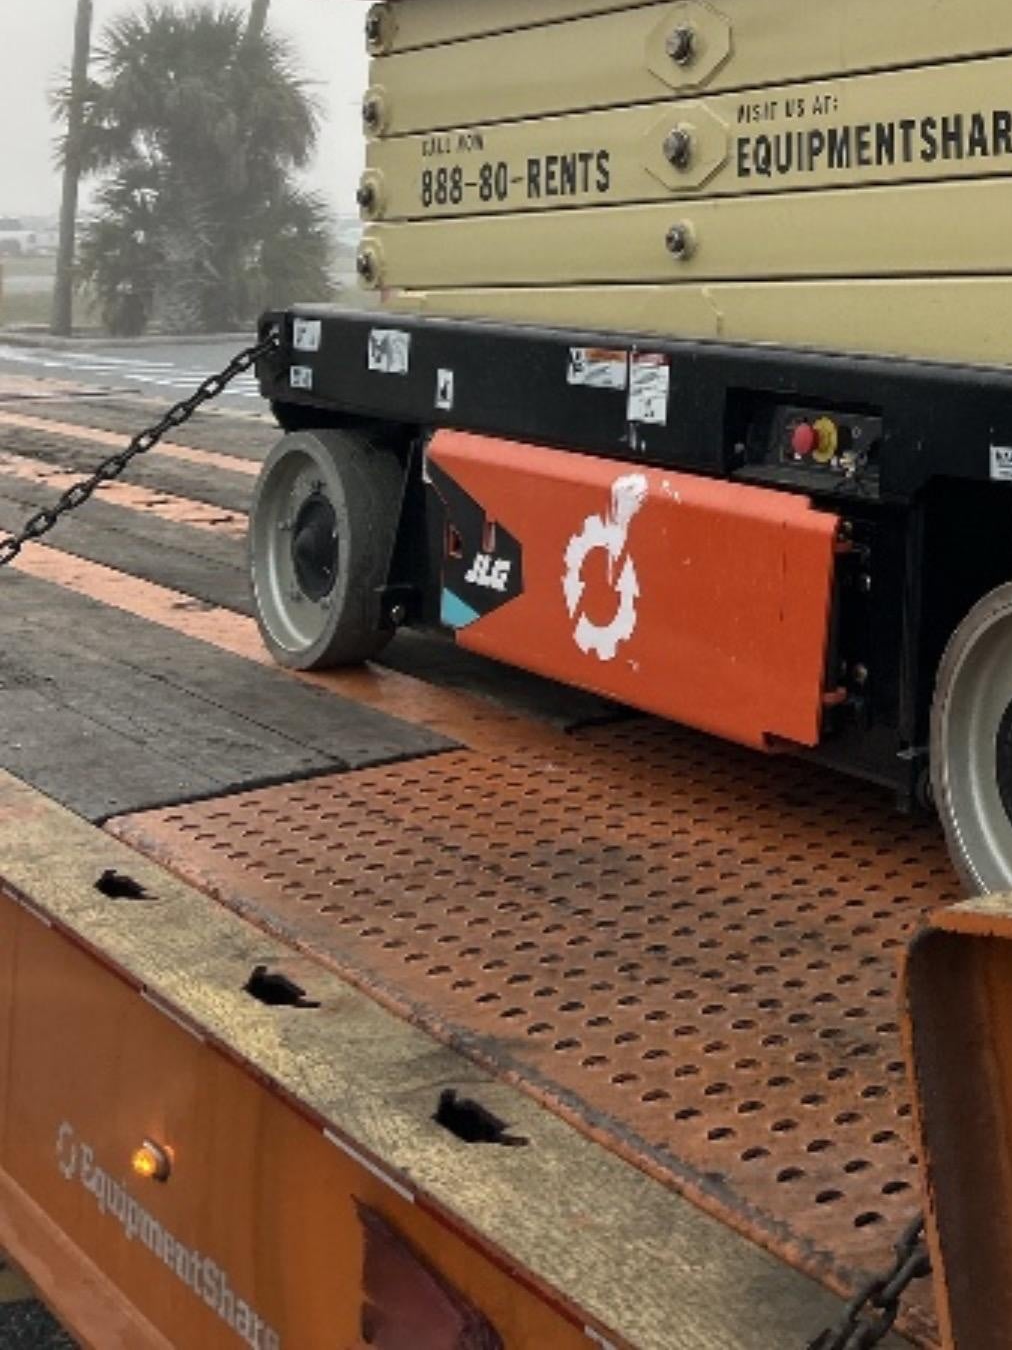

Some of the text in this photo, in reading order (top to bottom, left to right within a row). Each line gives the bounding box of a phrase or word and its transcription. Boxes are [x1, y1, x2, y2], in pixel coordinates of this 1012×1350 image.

[737, 95, 839, 123] VISIT US AT:
[421, 149, 610, 207] 888-80-RENTS
[463, 551, 511, 592] JLG
